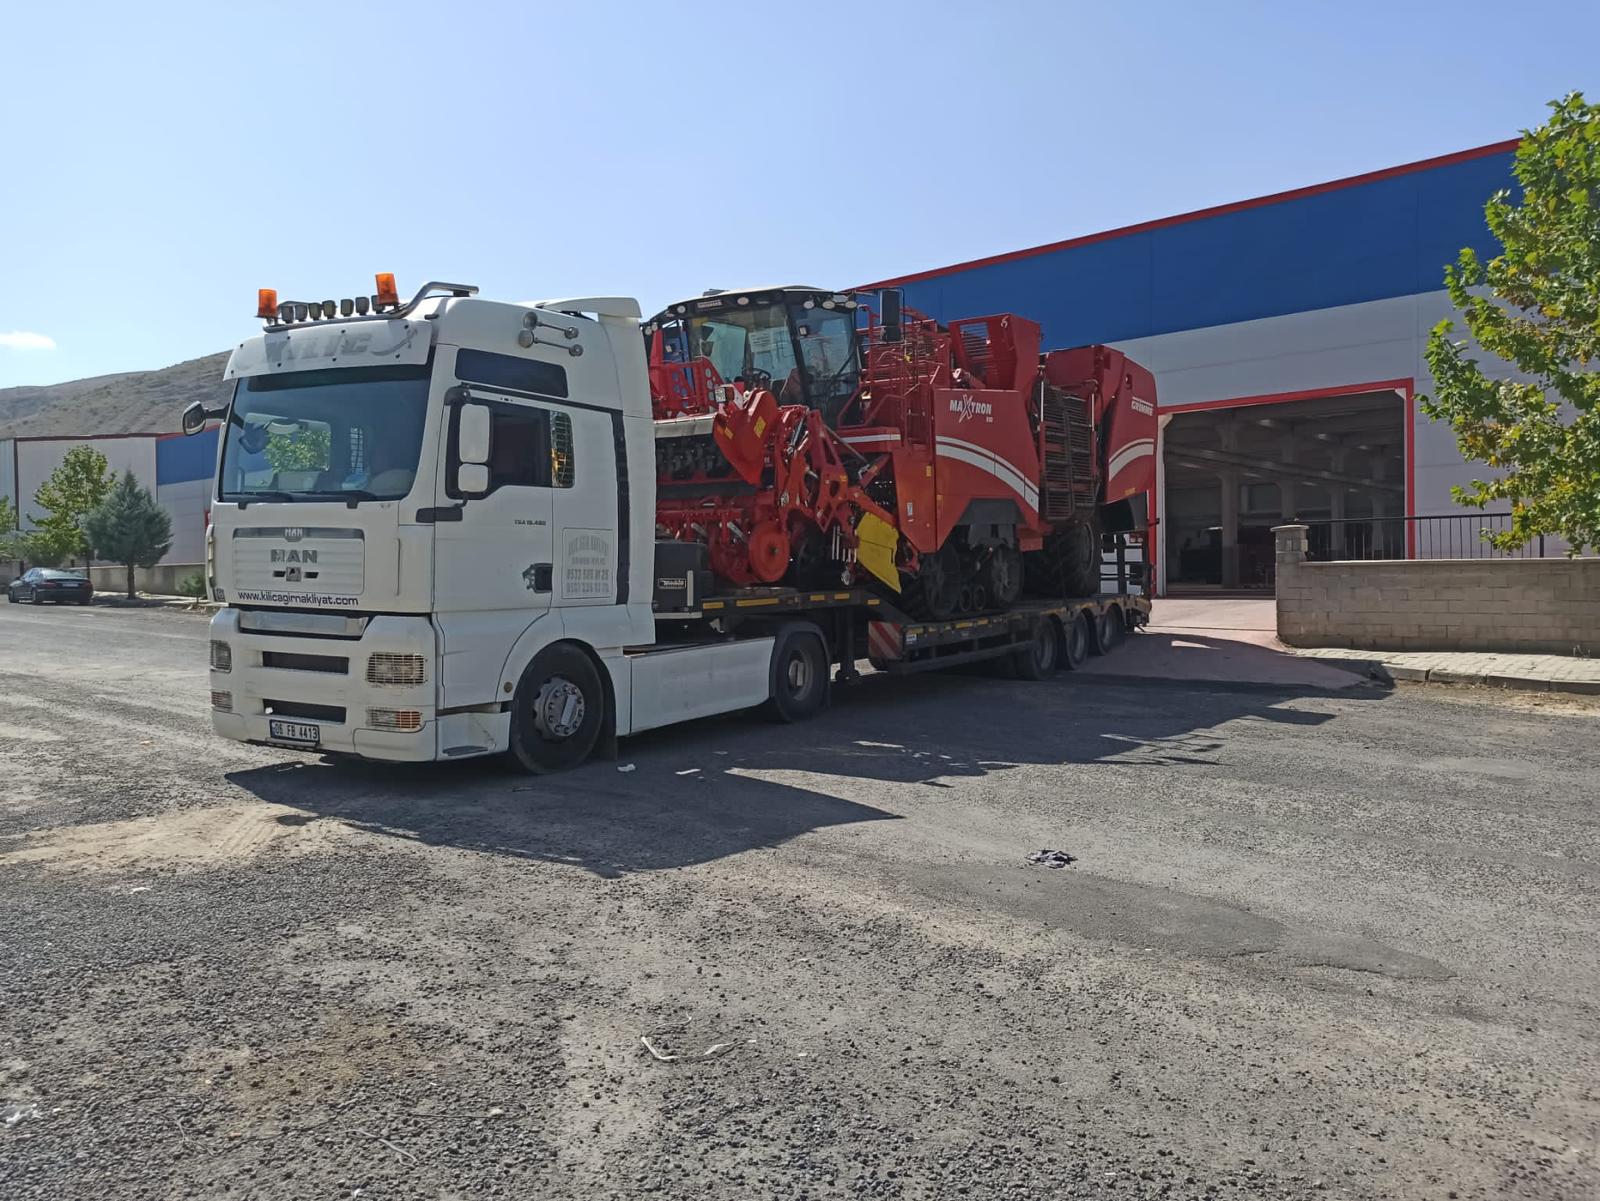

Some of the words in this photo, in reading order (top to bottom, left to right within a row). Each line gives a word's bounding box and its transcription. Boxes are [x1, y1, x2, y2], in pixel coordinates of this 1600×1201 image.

[950, 394, 992, 423] MAXTRON
[284, 528, 302, 537] MAN
[270, 549, 318, 563] MAN
[238, 590, 359, 607] www.kilicagirnakliyat.com
[287, 724, 296, 737] FB
[299, 726, 318, 740] 4413
